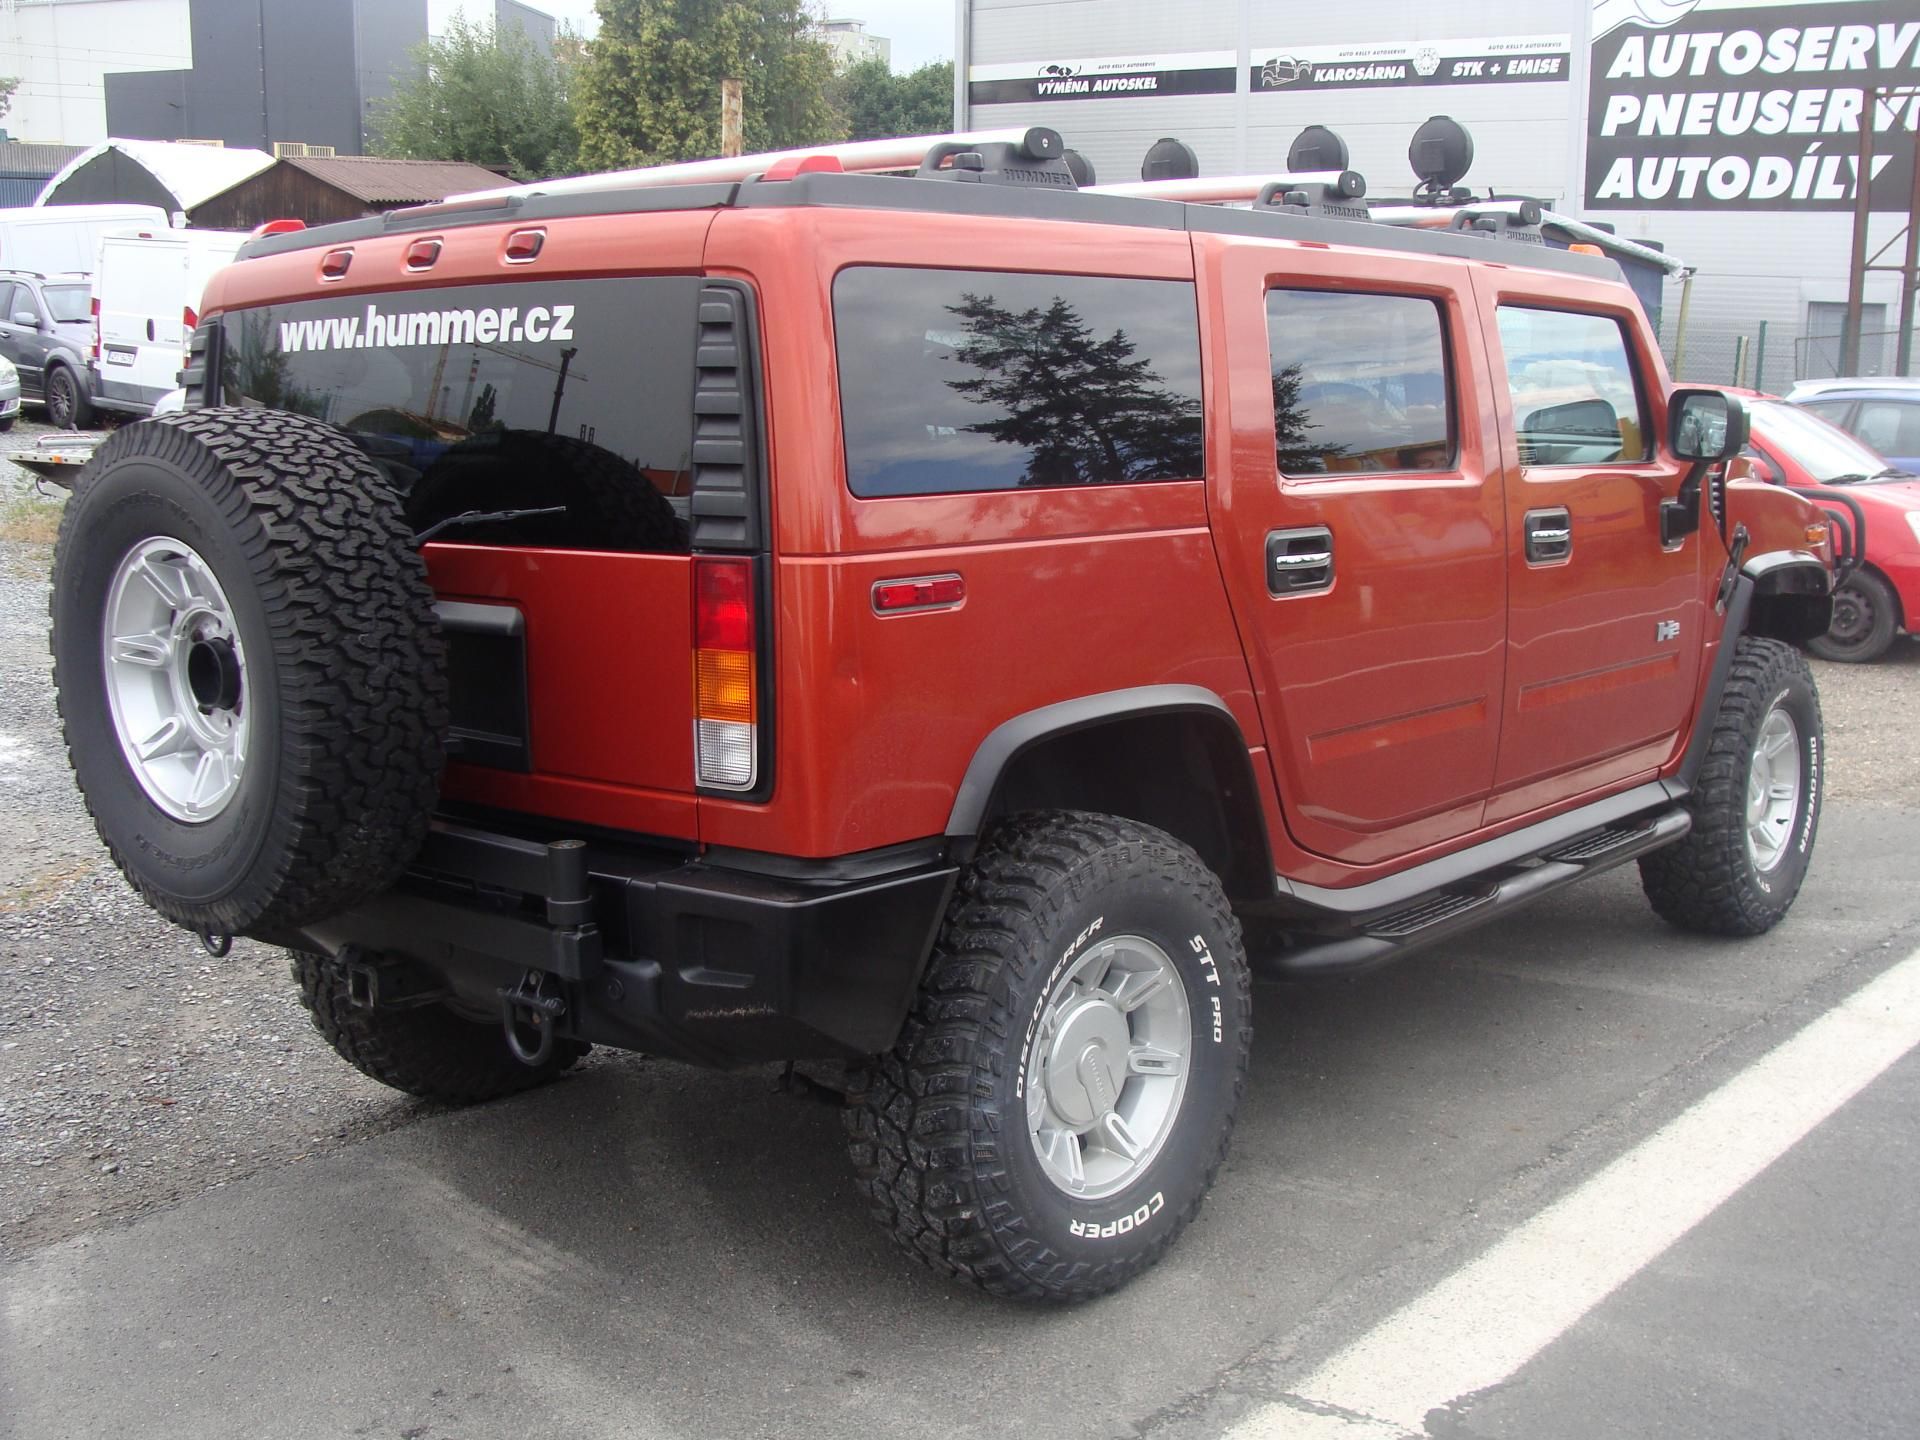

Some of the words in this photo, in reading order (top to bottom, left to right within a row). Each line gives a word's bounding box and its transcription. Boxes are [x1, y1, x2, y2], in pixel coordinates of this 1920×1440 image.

[1313, 63, 1406, 82] KAROSÁRNA
[1451, 61, 1486, 77] STK
[1489, 63, 1501, 76] +
[1506, 58, 1562, 75] EMISE
[1038, 79, 1089, 95] VÝMĚNA
[1092, 77, 1158, 92] AUTOSKEL
[1003, 168, 1072, 186] HUMMER
[1322, 204, 1369, 220] HUMMER
[280, 304, 575, 353] www.hummer.cz
[1656, 619, 1680, 642] H2
[1799, 735, 1818, 854] DISCOVERER
[1188, 933, 1221, 987] STT
[1210, 996, 1222, 1043] PRO
[1015, 915, 1104, 1100] DISCOVERER
[1069, 1191, 1165, 1239] COOPER
